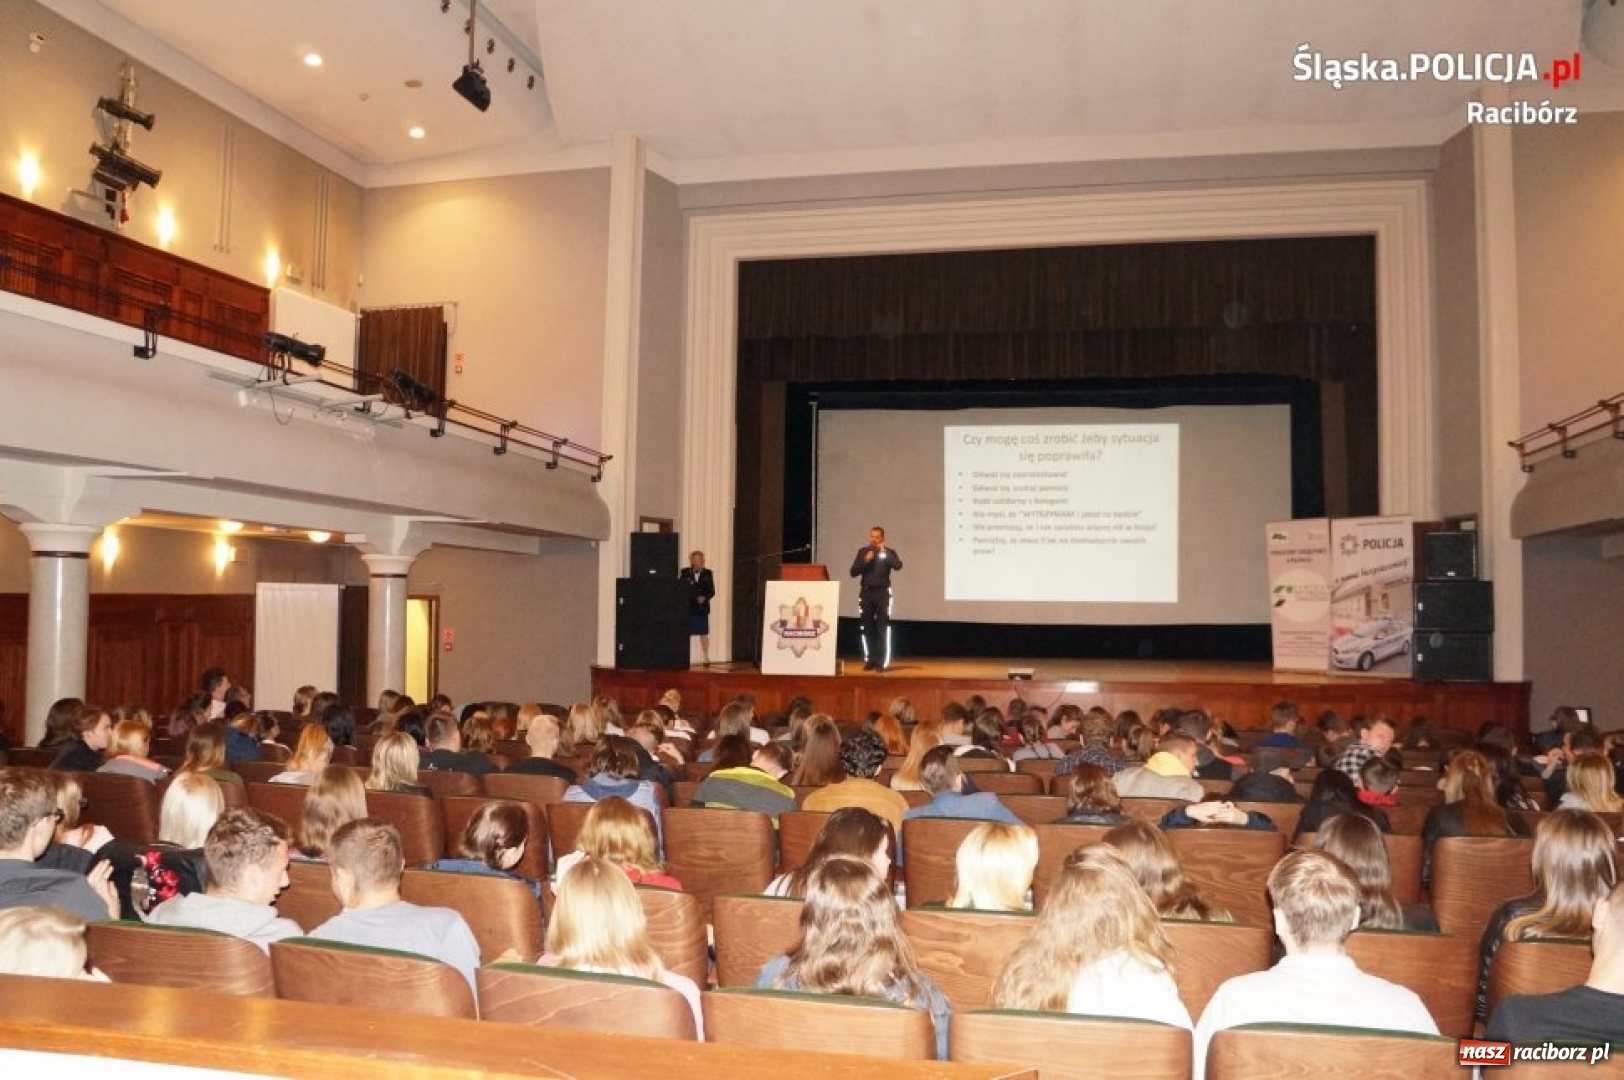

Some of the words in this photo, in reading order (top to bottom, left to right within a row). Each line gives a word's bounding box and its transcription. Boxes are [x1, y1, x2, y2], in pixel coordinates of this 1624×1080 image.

[963, 434, 982, 446] Czy
[986, 436, 1018, 447] mogę
[1020, 433, 1040, 445] coś
[1043, 433, 1078, 444] zrobić
[1081, 433, 1106, 446] żeby
[1111, 433, 1159, 446] sytuacja
[1018, 450, 1034, 462] się
[1037, 449, 1102, 463] poprawiła?
[1362, 538, 1404, 550] POLICJA
